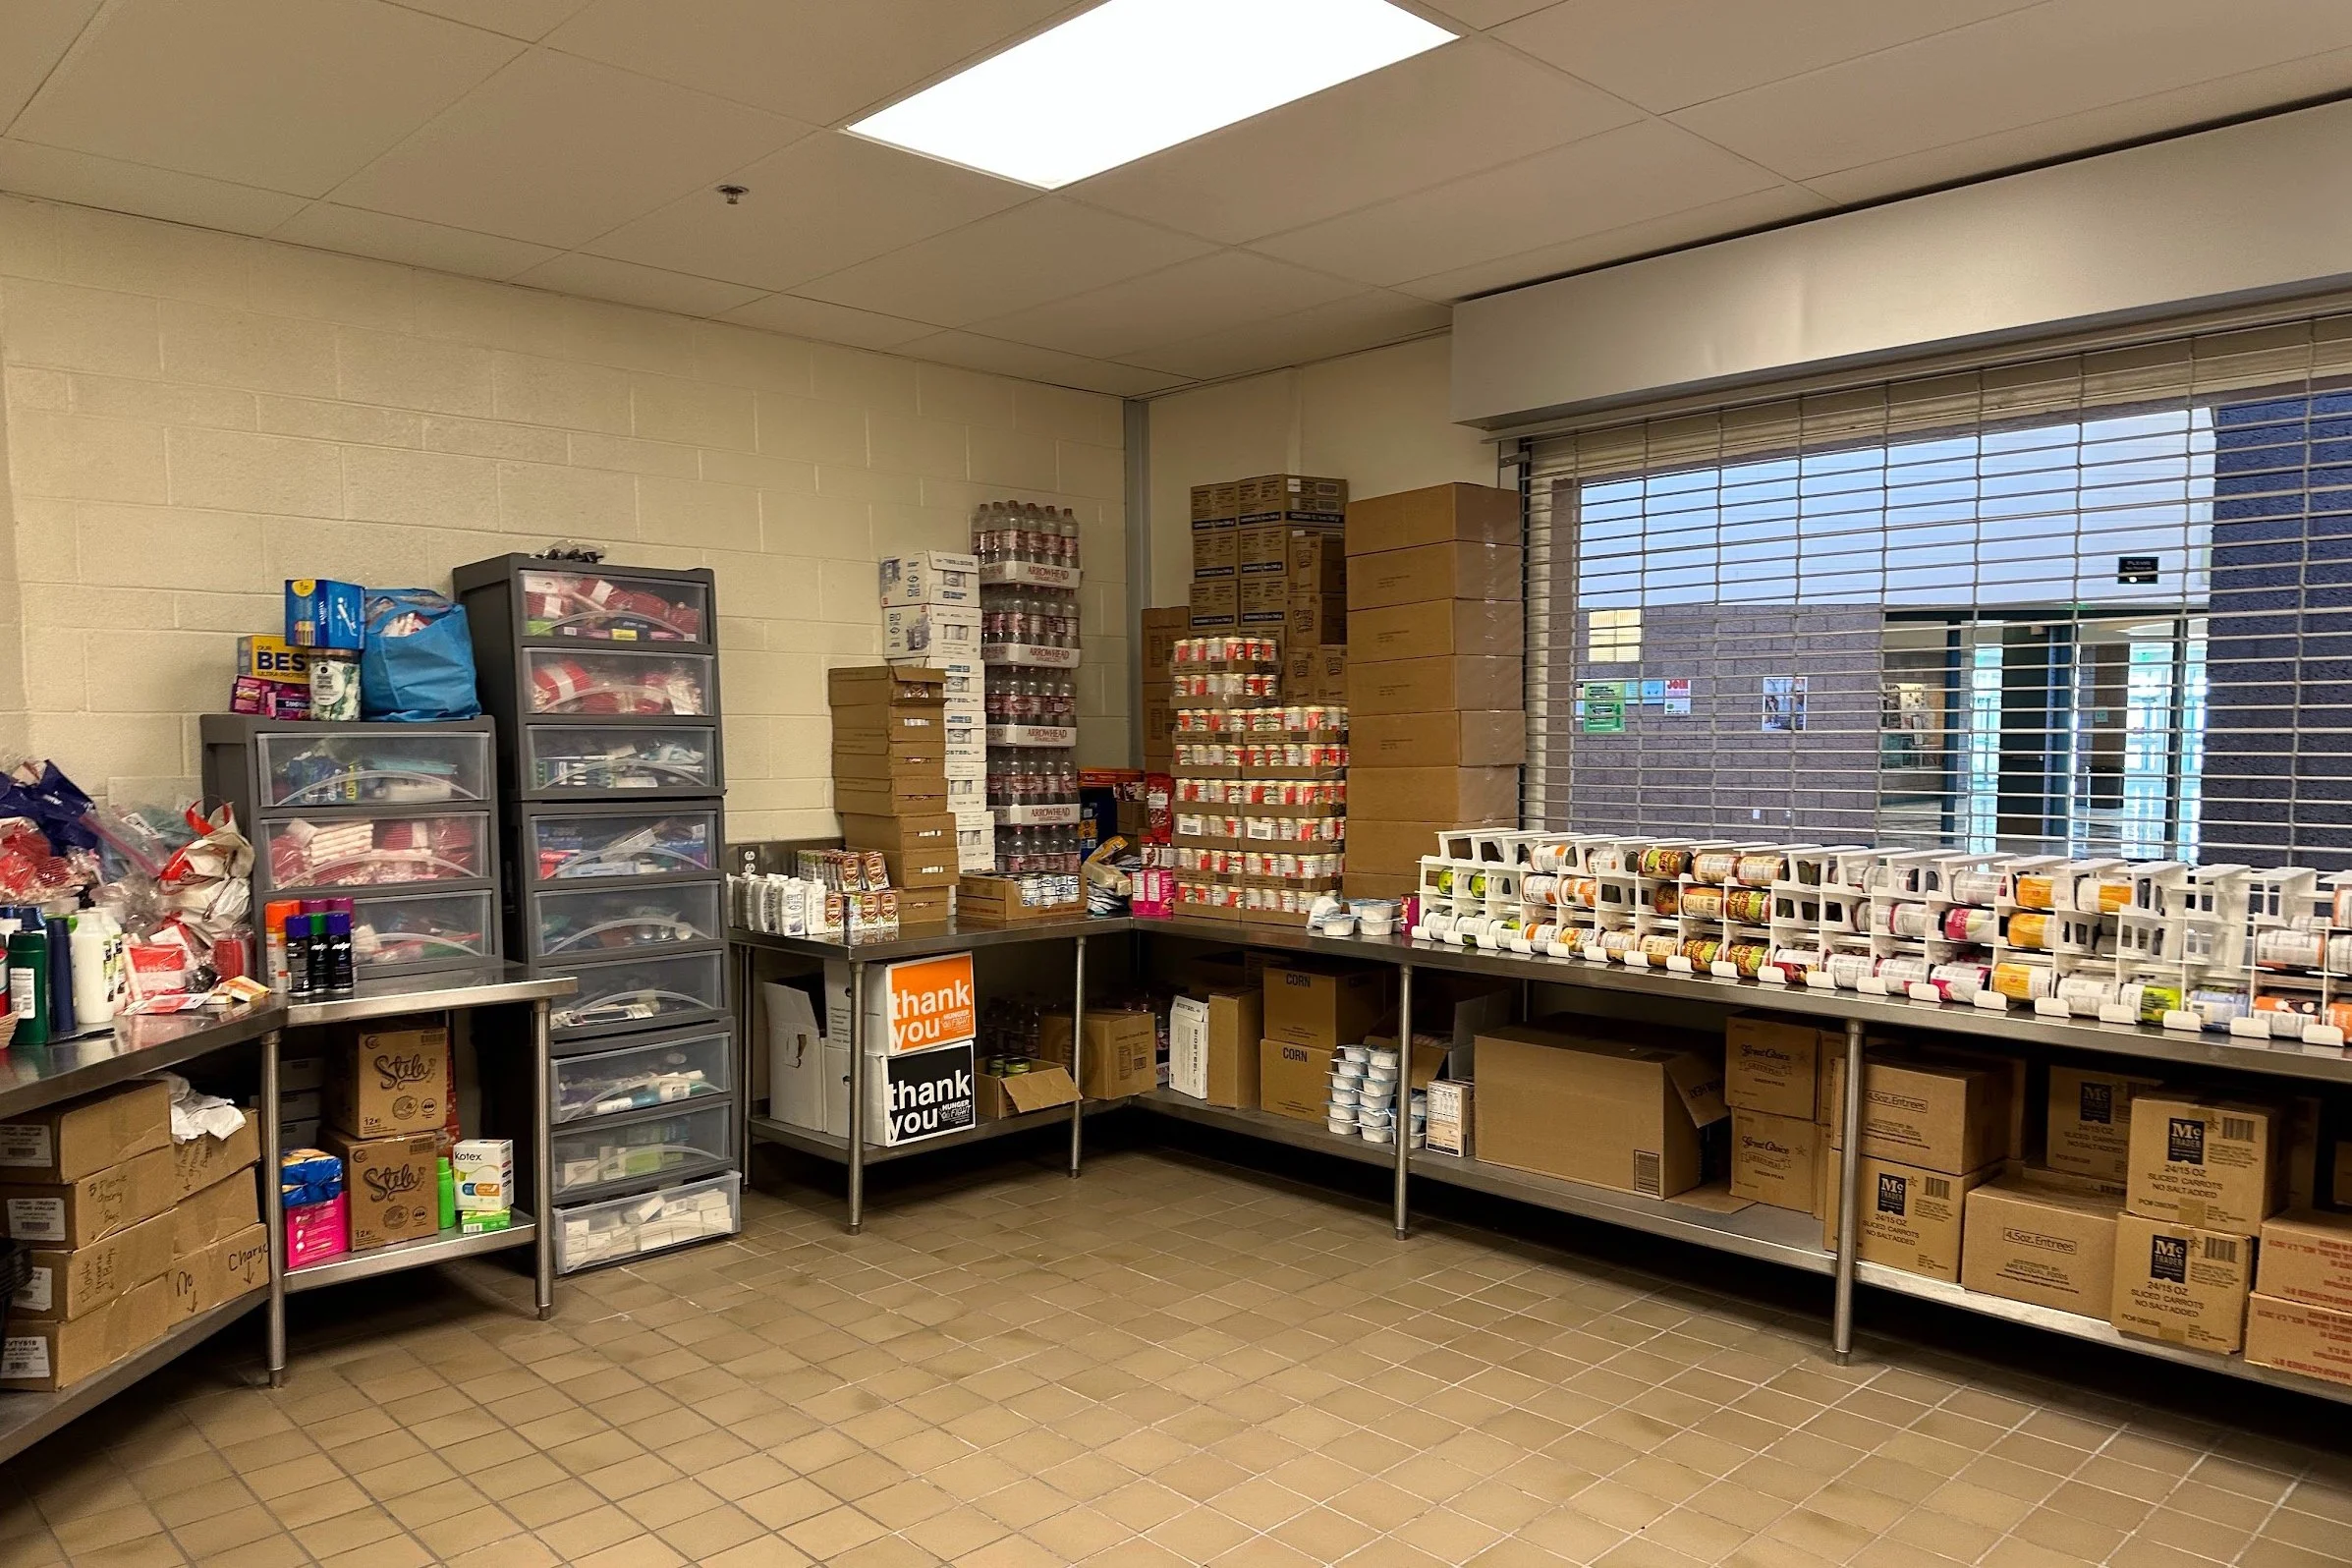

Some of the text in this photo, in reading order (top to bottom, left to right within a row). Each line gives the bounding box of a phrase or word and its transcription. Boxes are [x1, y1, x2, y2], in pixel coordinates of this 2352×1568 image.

[1028, 566, 1069, 580] ARROWHEAD
[1030, 647, 1070, 660] ARROWHEAD
[257, 651, 308, 672] BES
[1028, 728, 1067, 738] ARROWHEAD
[1031, 807, 1070, 817] ARROWHEAD
[1286, 973, 1311, 987] CORN
[892, 980, 971, 1020] thank
[892, 1018, 940, 1051] you
[1283, 1047, 1308, 1062] CORN
[374, 1054, 430, 1091] Stela
[888, 1070, 971, 1111] thank
[942, 1099, 969, 1110] HUNGER
[951, 1105, 971, 1117] FIGHT
[889, 1108, 937, 1142] you
[1742, 1136, 1790, 1154] Great Choice
[2171, 1137, 2201, 1148] TRADER
[455, 1151, 481, 1161] Kotex
[2192, 1168, 2207, 1177] OZ
[363, 1163, 420, 1203] Stela
[2148, 1172, 2223, 1190] SLICED CARROTS
[1880, 1190, 1903, 1202] TRADER
[2153, 1183, 2217, 1199] NO SALT ADDED
[1863, 1220, 1920, 1238] SLICED CARROTS
[1876, 1231, 1892, 1240] SALT
[1891, 1236, 1916, 1246] ADDED
[2036, 1236, 2074, 1253] Entrees
[2155, 1254, 2183, 1267] TRADER
[2173, 1286, 2189, 1296] OZ
[2131, 1288, 2205, 1310] SLICED CARROTS
[2135, 1299, 2200, 1317] NO SALT ADDED
